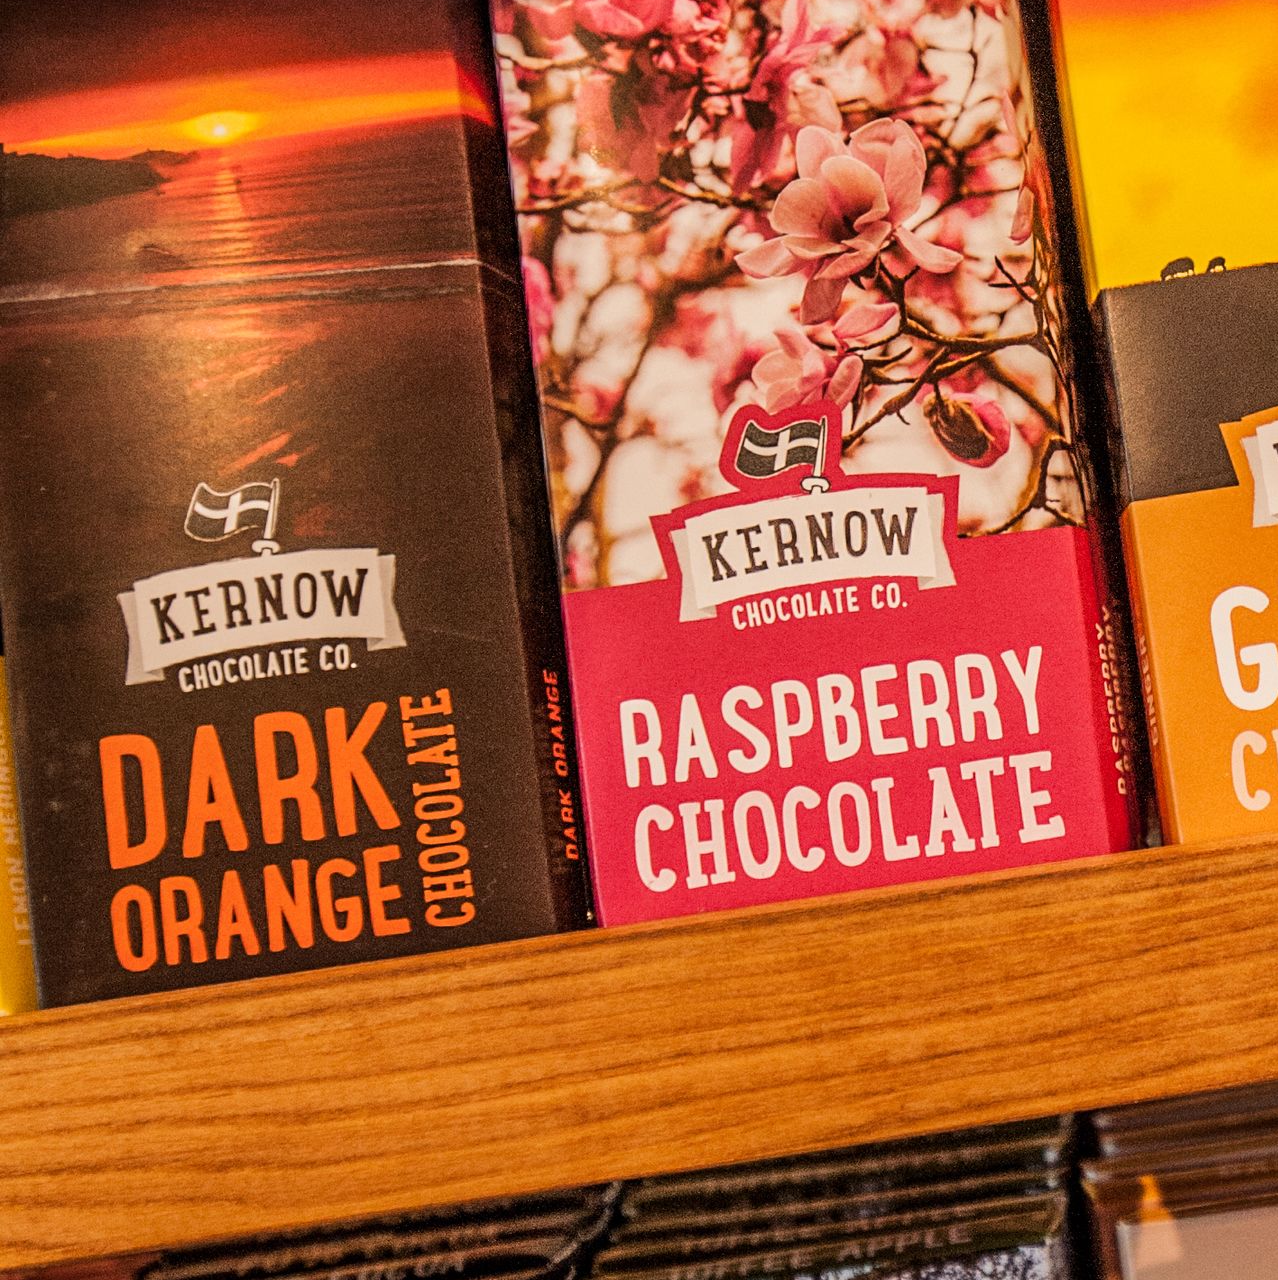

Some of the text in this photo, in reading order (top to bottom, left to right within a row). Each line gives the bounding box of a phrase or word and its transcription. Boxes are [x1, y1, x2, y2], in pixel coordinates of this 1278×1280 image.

[150, 567, 369, 644] KERNOW
[703, 507, 917, 582] KERNOW
[732, 583, 908, 631] CHOCOLATE CO.
[178, 643, 358, 693] CHOCOLATE CO.
[619, 645, 1044, 789] RASPBERRY
[1095, 622, 1127, 795] RASPBERRY
[1139, 635, 1159, 747] GINGER
[99, 701, 401, 870] DARK
[399, 687, 476, 928] CHOCOLATE
[543, 669, 580, 861] DARK ORANGE
[634, 750, 1066, 894] CHOCOLATE
[110, 845, 412, 973] ORANGE
